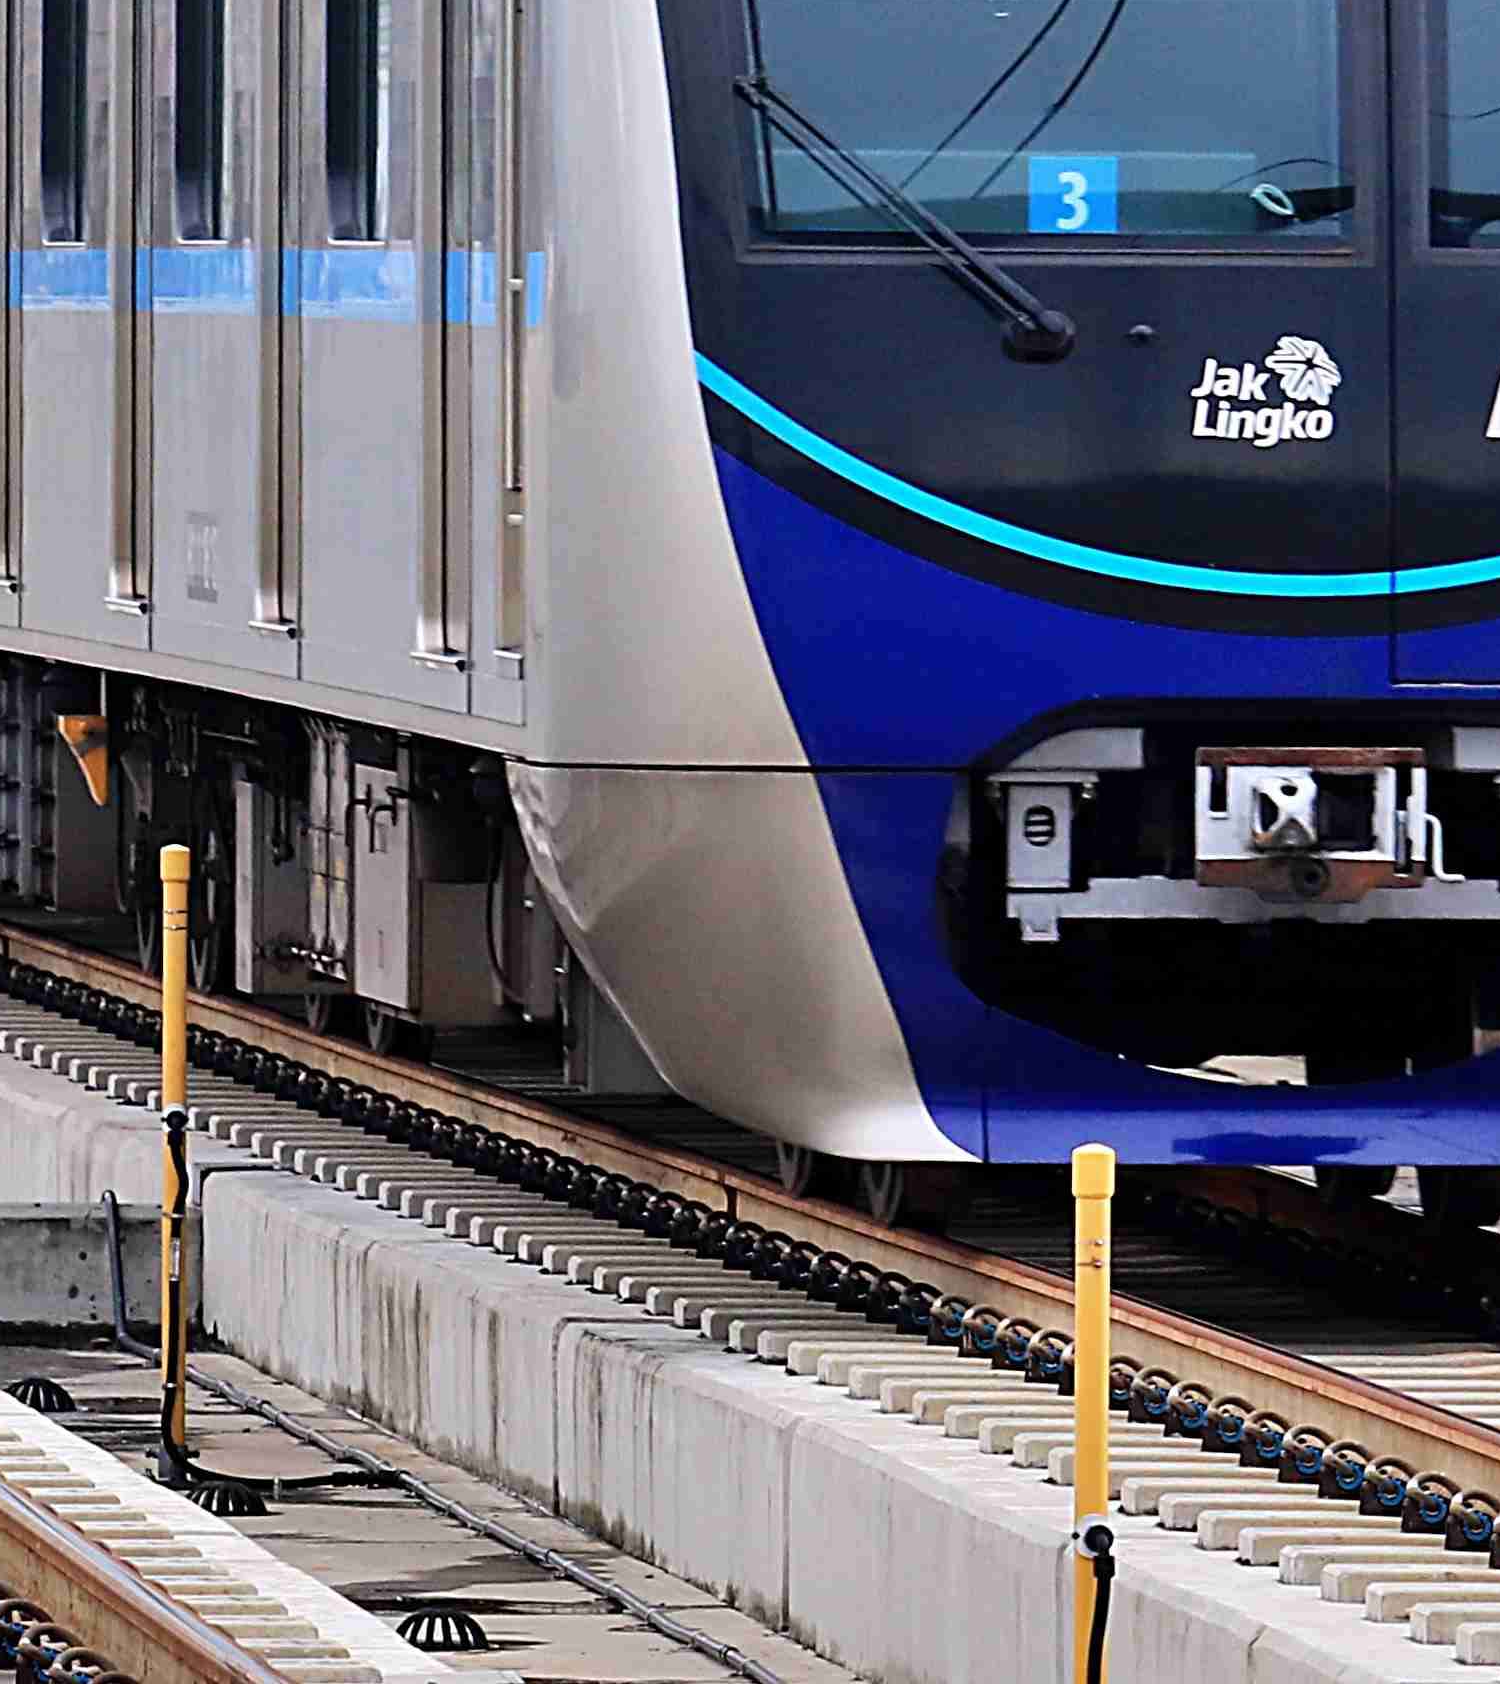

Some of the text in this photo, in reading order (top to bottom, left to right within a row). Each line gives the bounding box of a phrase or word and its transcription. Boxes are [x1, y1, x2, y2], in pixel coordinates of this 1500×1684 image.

[1056, 171, 1089, 230] 3
[1190, 358, 1271, 401] Jak
[1192, 398, 1334, 447] Lingko
